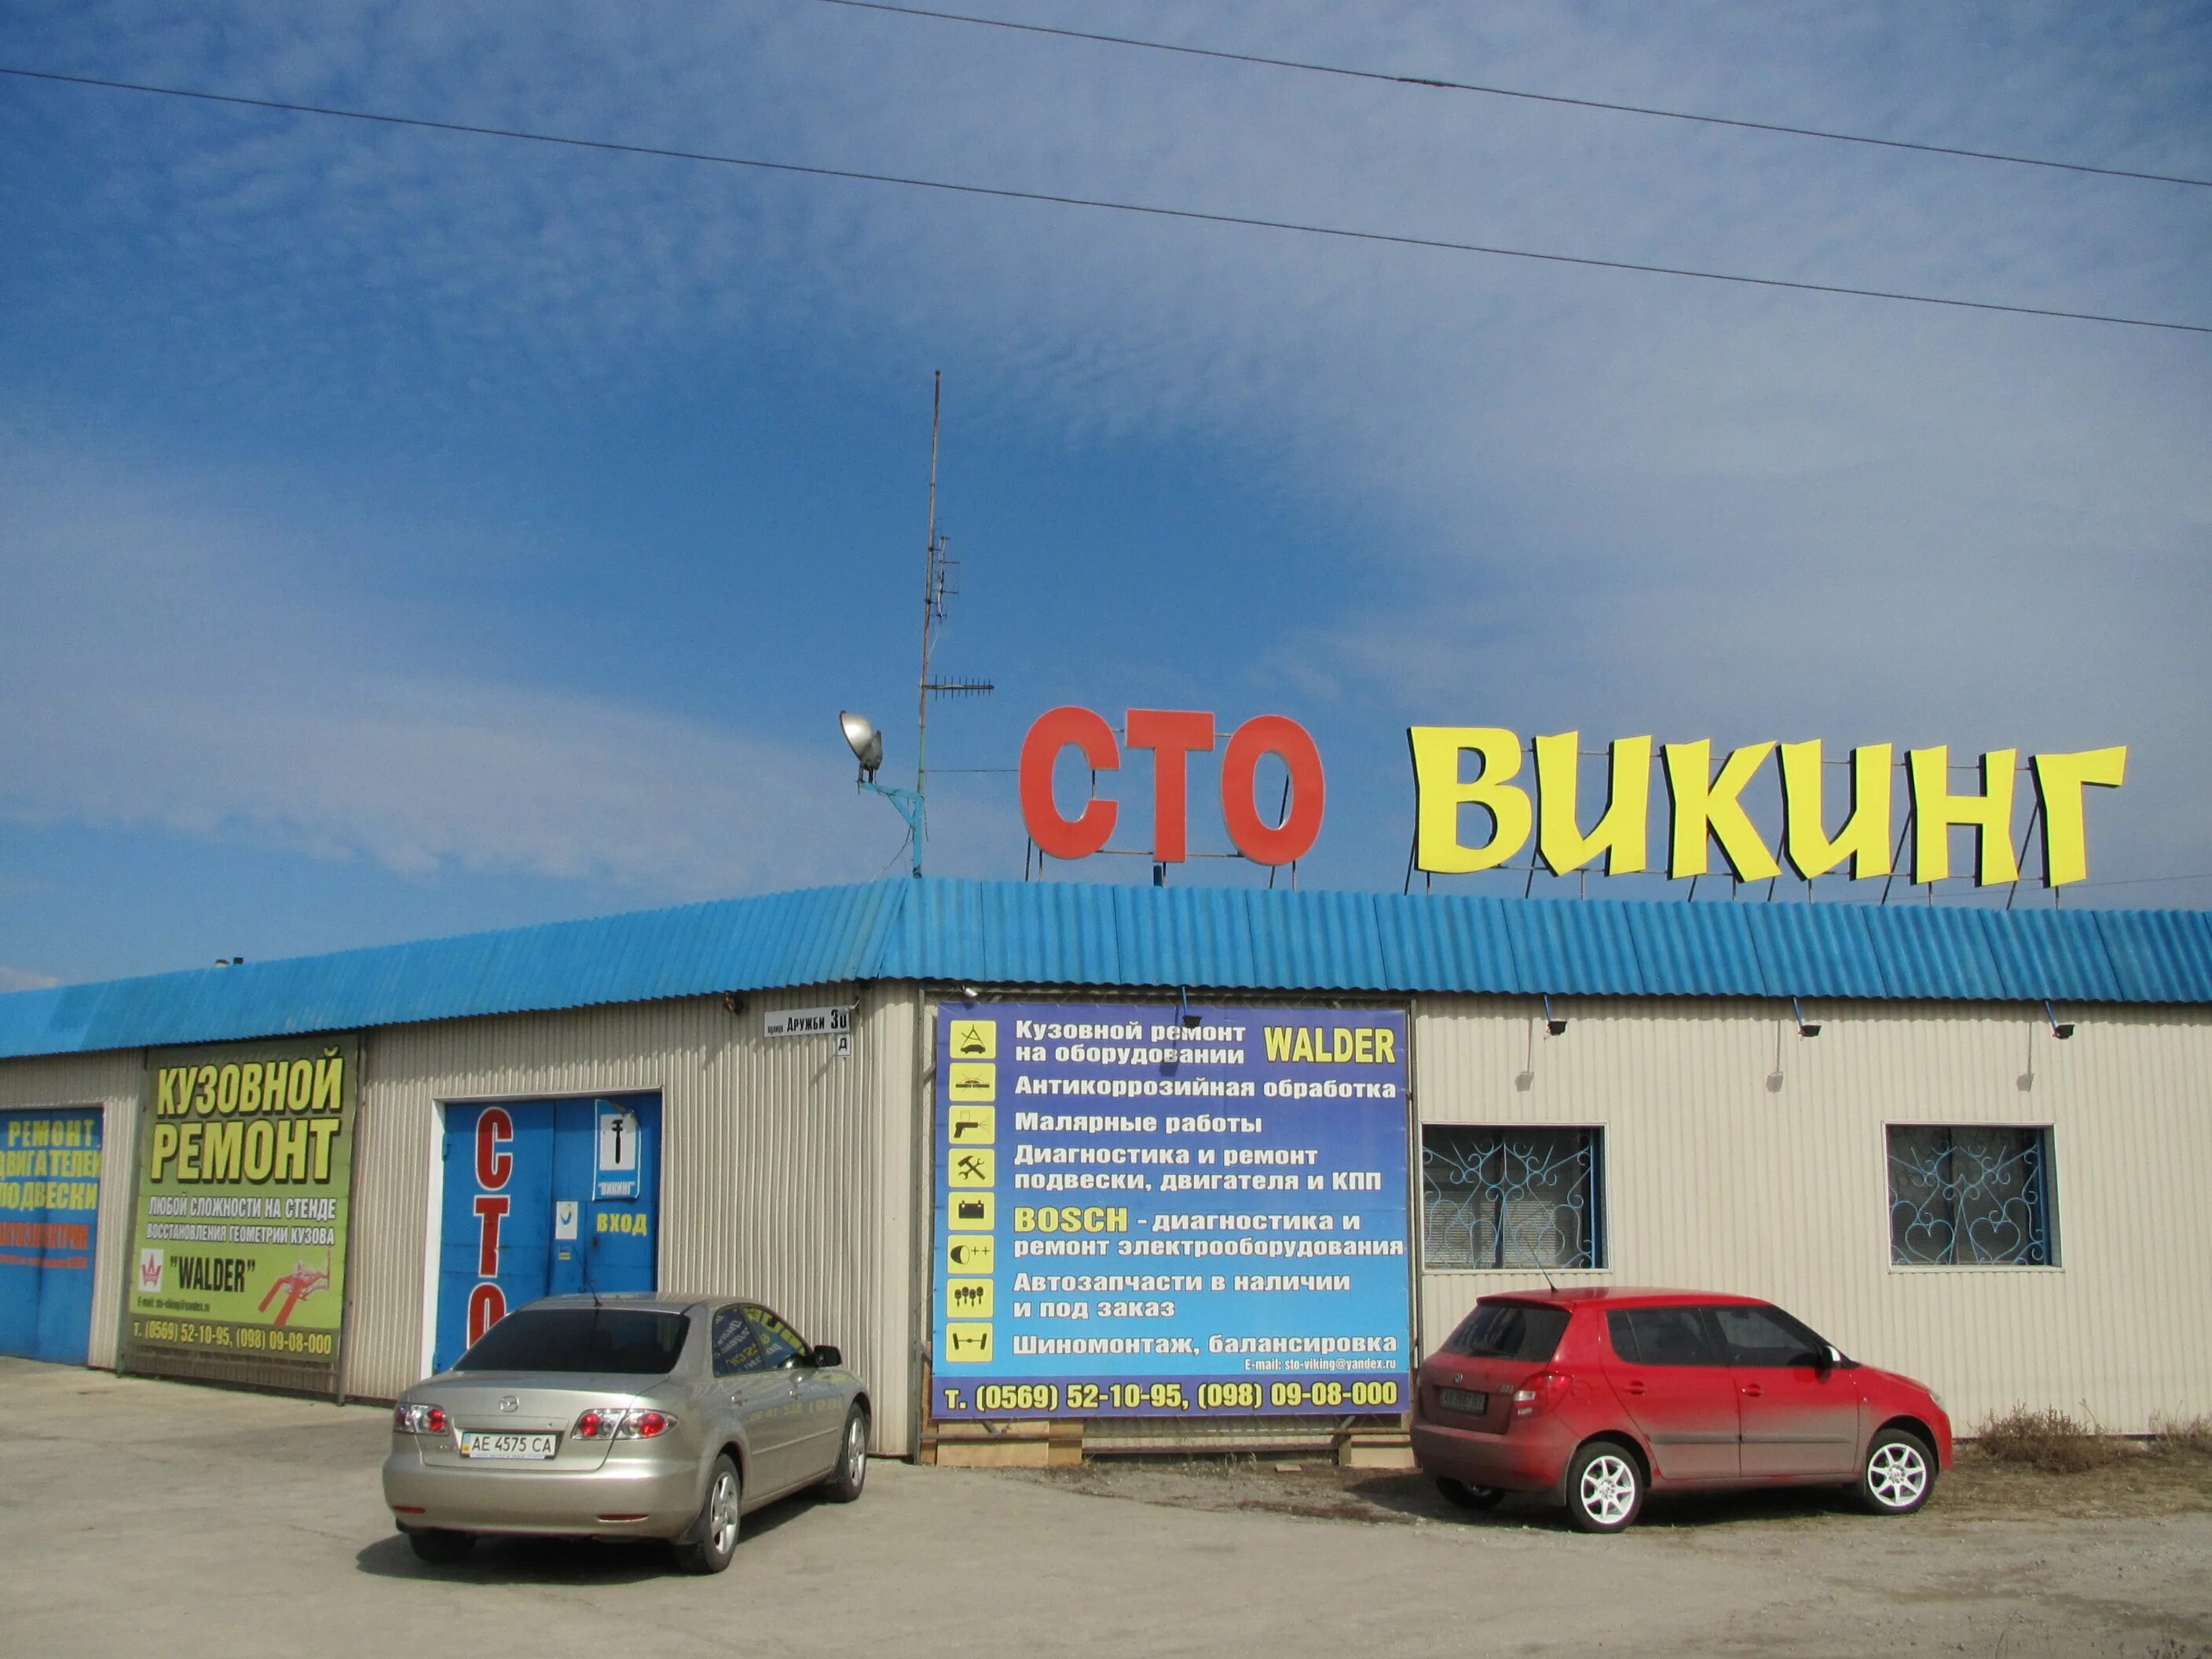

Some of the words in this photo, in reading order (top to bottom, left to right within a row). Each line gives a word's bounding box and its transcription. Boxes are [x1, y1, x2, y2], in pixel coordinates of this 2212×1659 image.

[1019, 705, 1326, 866] СТО
[1408, 725, 2128, 888] ВИКИНГ
[1015, 1020, 1142, 1041] Кузовной
[1151, 1025, 1246, 1042] ремонт
[1015, 1046, 1046, 1062] на
[1055, 1044, 1245, 1064] оборудовании
[1264, 1026, 1396, 1064] WALDER
[157, 1046, 345, 1118] КУЗОВНОЙ
[1015, 1075, 1255, 1098] Антикоррозийная
[1263, 1079, 1397, 1100] обработка
[8, 1119, 95, 1148] РЕМОНТ
[1015, 1112, 1157, 1133] Малярные
[1166, 1113, 1262, 1134] работы
[151, 1119, 340, 1182] РЕМОНТ
[1014, 1144, 1190, 1166] Диагностика
[1197, 1149, 1215, 1164] и
[1224, 1148, 1318, 1166] ремонт
[1015, 1174, 1152, 1191] подвески,
[1160, 1173, 1296, 1192] двигателя
[1304, 1174, 1324, 1189] и
[1332, 1172, 1382, 1191] КПП
[148, 1191, 188, 1217] ЛЮБОЙ
[190, 1196, 262, 1218] СЛОЖНОСТИ
[265, 1198, 281, 1218] НА
[285, 1198, 337, 1221] СТЕНДЕ
[596, 1212, 647, 1236] ВХОД
[1014, 1207, 1128, 1232] BOSCH
[1342, 1214, 1361, 1230] и
[146, 1222, 227, 1242] ВОССТАНОВЛЕНИЯ
[229, 1225, 288, 1245] ГЕОМЕТРИИ
[290, 1227, 335, 1245] КУЗОВА
[1014, 1240, 1110, 1257] ремонт
[1117, 1236, 1404, 1258] электрооборудования
[1013, 1273, 1203, 1292] Автозапчасти
[1210, 1275, 1225, 1291] в
[1234, 1274, 1351, 1291] наличии
[1013, 1302, 1031, 1318] и
[1040, 1302, 1089, 1320] под
[1097, 1300, 1175, 1317] заказ
[145, 1320, 178, 1342] (0569)
[181, 1323, 234, 1349] 52-10-95,
[236, 1328, 266, 1346] (098)
[269, 1331, 333, 1354] 09-08-000
[1013, 1335, 1200, 1357] Шиномонтаж,
[1209, 1334, 1397, 1354] балансировка
[1244, 1358, 1282, 1371] E-mail:
[1284, 1358, 1397, 1371] sto-viking@yandex.ru
[976, 1384, 1059, 1412] (0569)
[1067, 1382, 1190, 1410] 52-10-95,
[1198, 1382, 1262, 1410] (098)
[1271, 1381, 1398, 1407] 09-08-000
[494, 1437, 527, 1452] 4575
